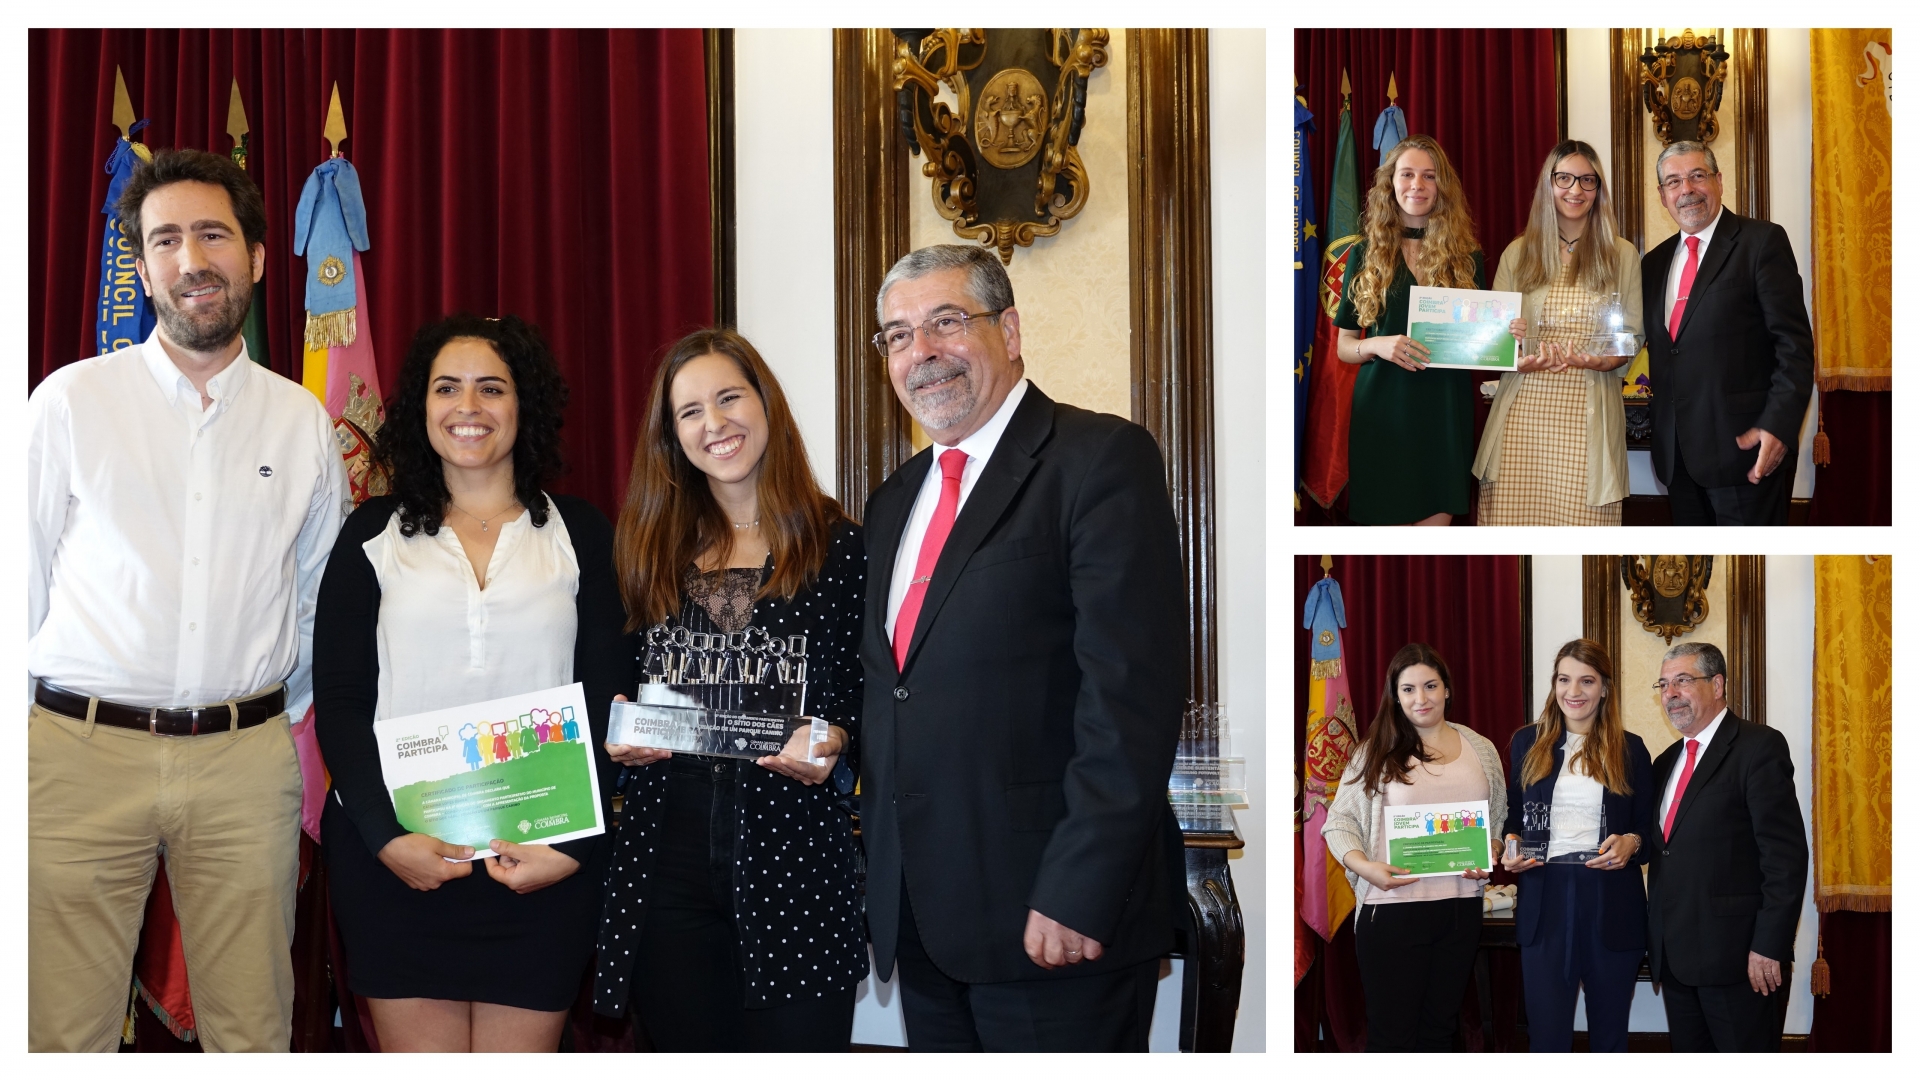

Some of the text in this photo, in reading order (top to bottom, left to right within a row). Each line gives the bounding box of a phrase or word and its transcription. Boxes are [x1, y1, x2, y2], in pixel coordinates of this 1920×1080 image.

[634, 718, 677, 729] COIMBRA
[766, 722, 784, 730] CÃES
[396, 736, 442, 751] COIMBRA
[750, 743, 781, 752] COIMBRA
[398, 744, 448, 760] PARTICIPA
[535, 816, 570, 830] COIMBRA
